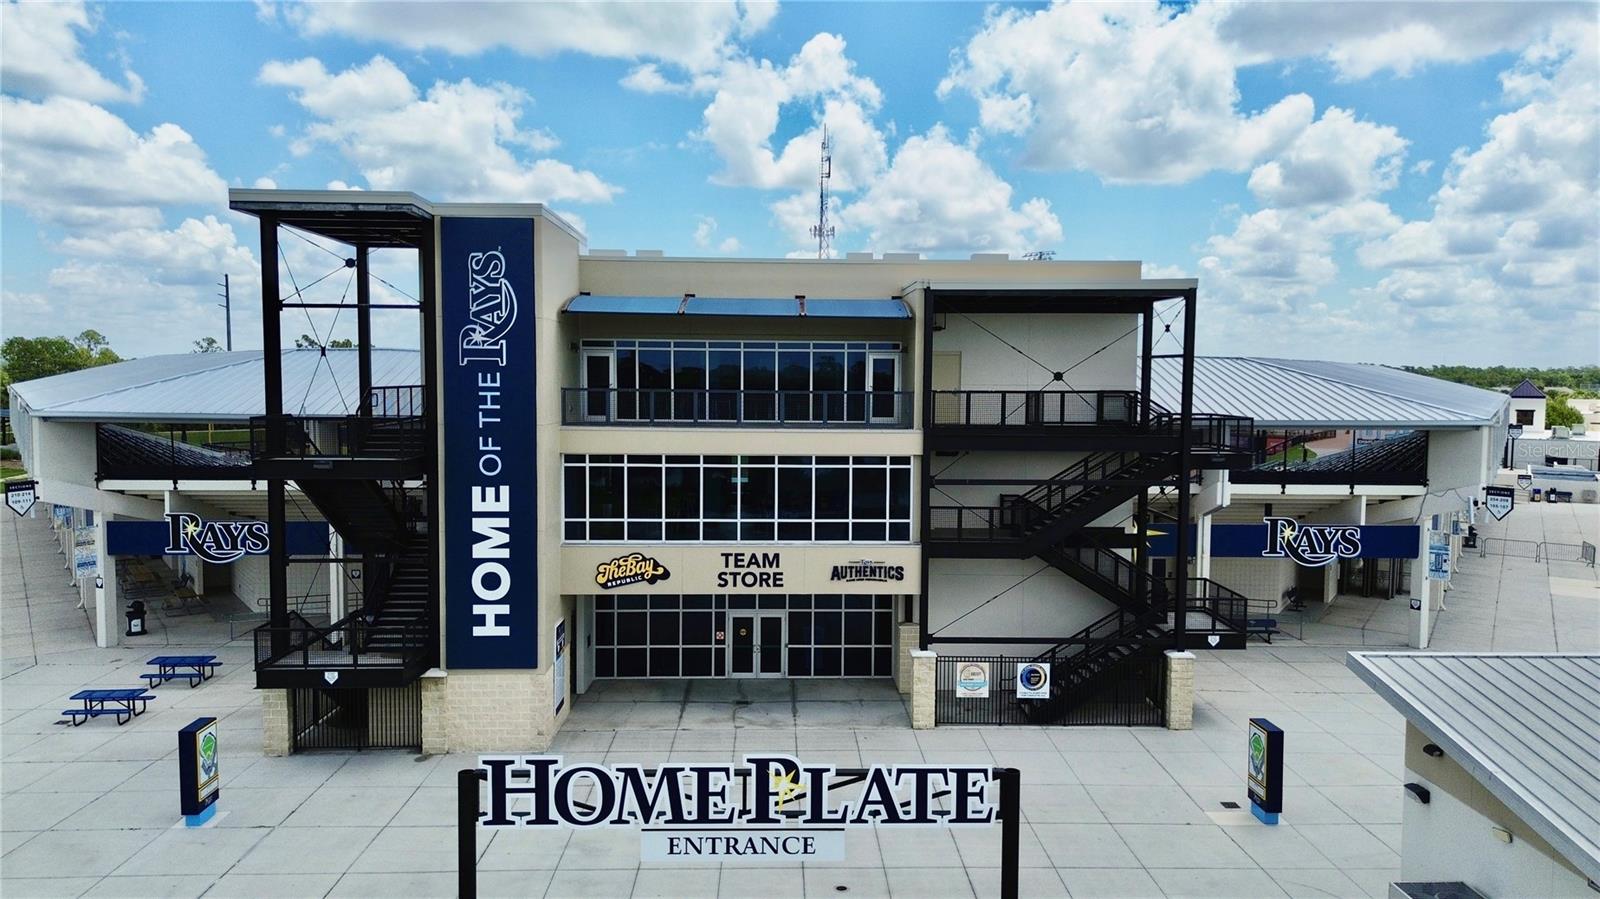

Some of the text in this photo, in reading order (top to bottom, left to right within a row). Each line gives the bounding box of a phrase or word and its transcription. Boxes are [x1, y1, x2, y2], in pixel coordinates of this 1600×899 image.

[459, 250, 518, 637] HOME OF THE RAYS
[164, 512, 270, 564] RAYS
[1262, 516, 1362, 567] RAYS
[720, 552, 781, 569] TEAM
[607, 575, 643, 587] REPUBLIC
[717, 572, 784, 588] STORE
[830, 565, 905, 581] AUTHENTICS
[481, 756, 995, 826] HOME PLATE
[667, 836, 817, 856] ENTRANCE
